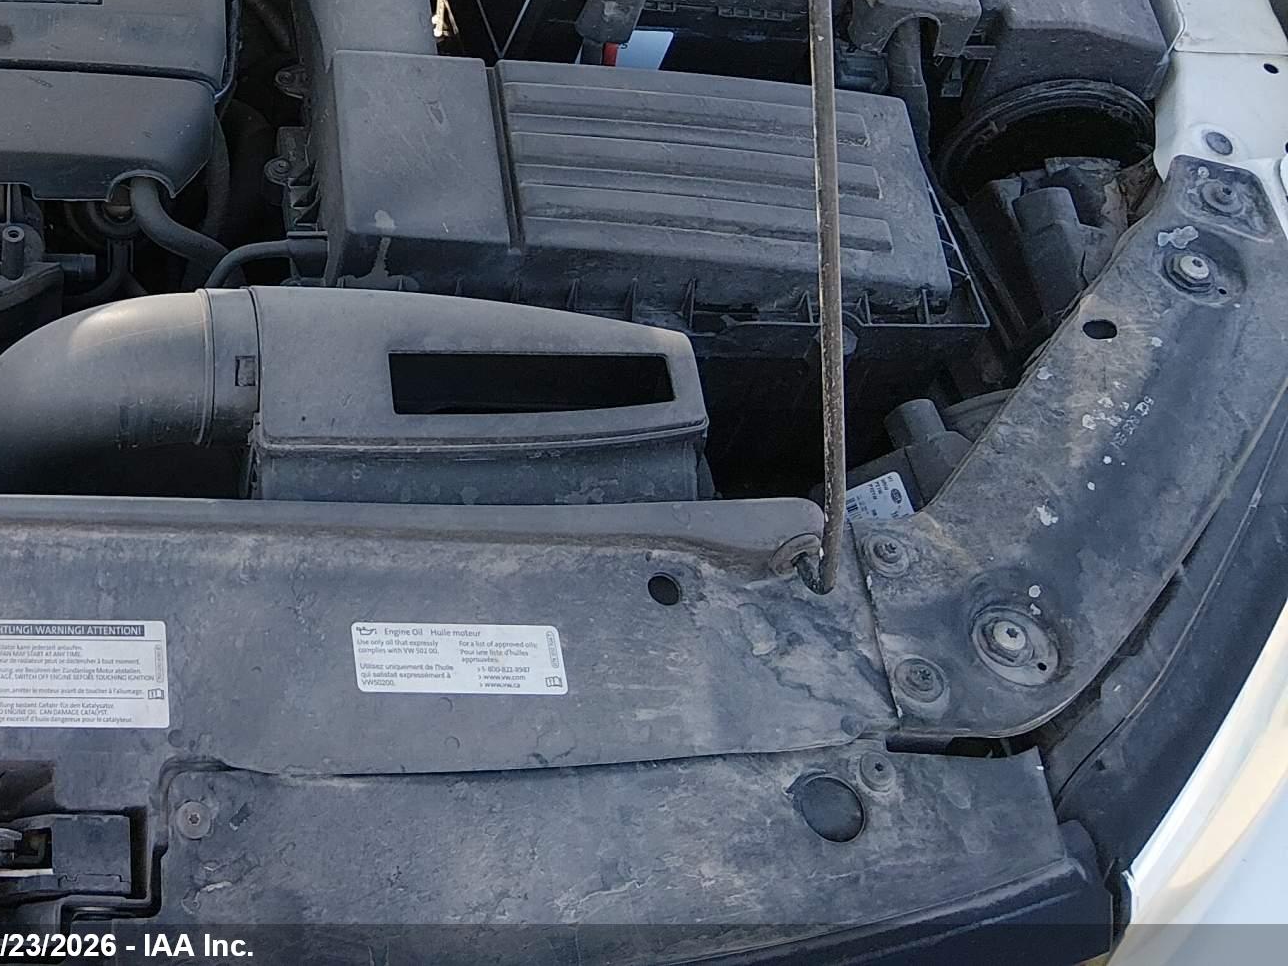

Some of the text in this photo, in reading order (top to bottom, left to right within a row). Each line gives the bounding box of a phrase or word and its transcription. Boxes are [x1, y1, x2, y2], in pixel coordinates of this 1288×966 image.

[34, 625, 85, 635] WARNING!
[86, 625, 142, 635] ATTENTION!
[384, 628, 411, 637] Engine
